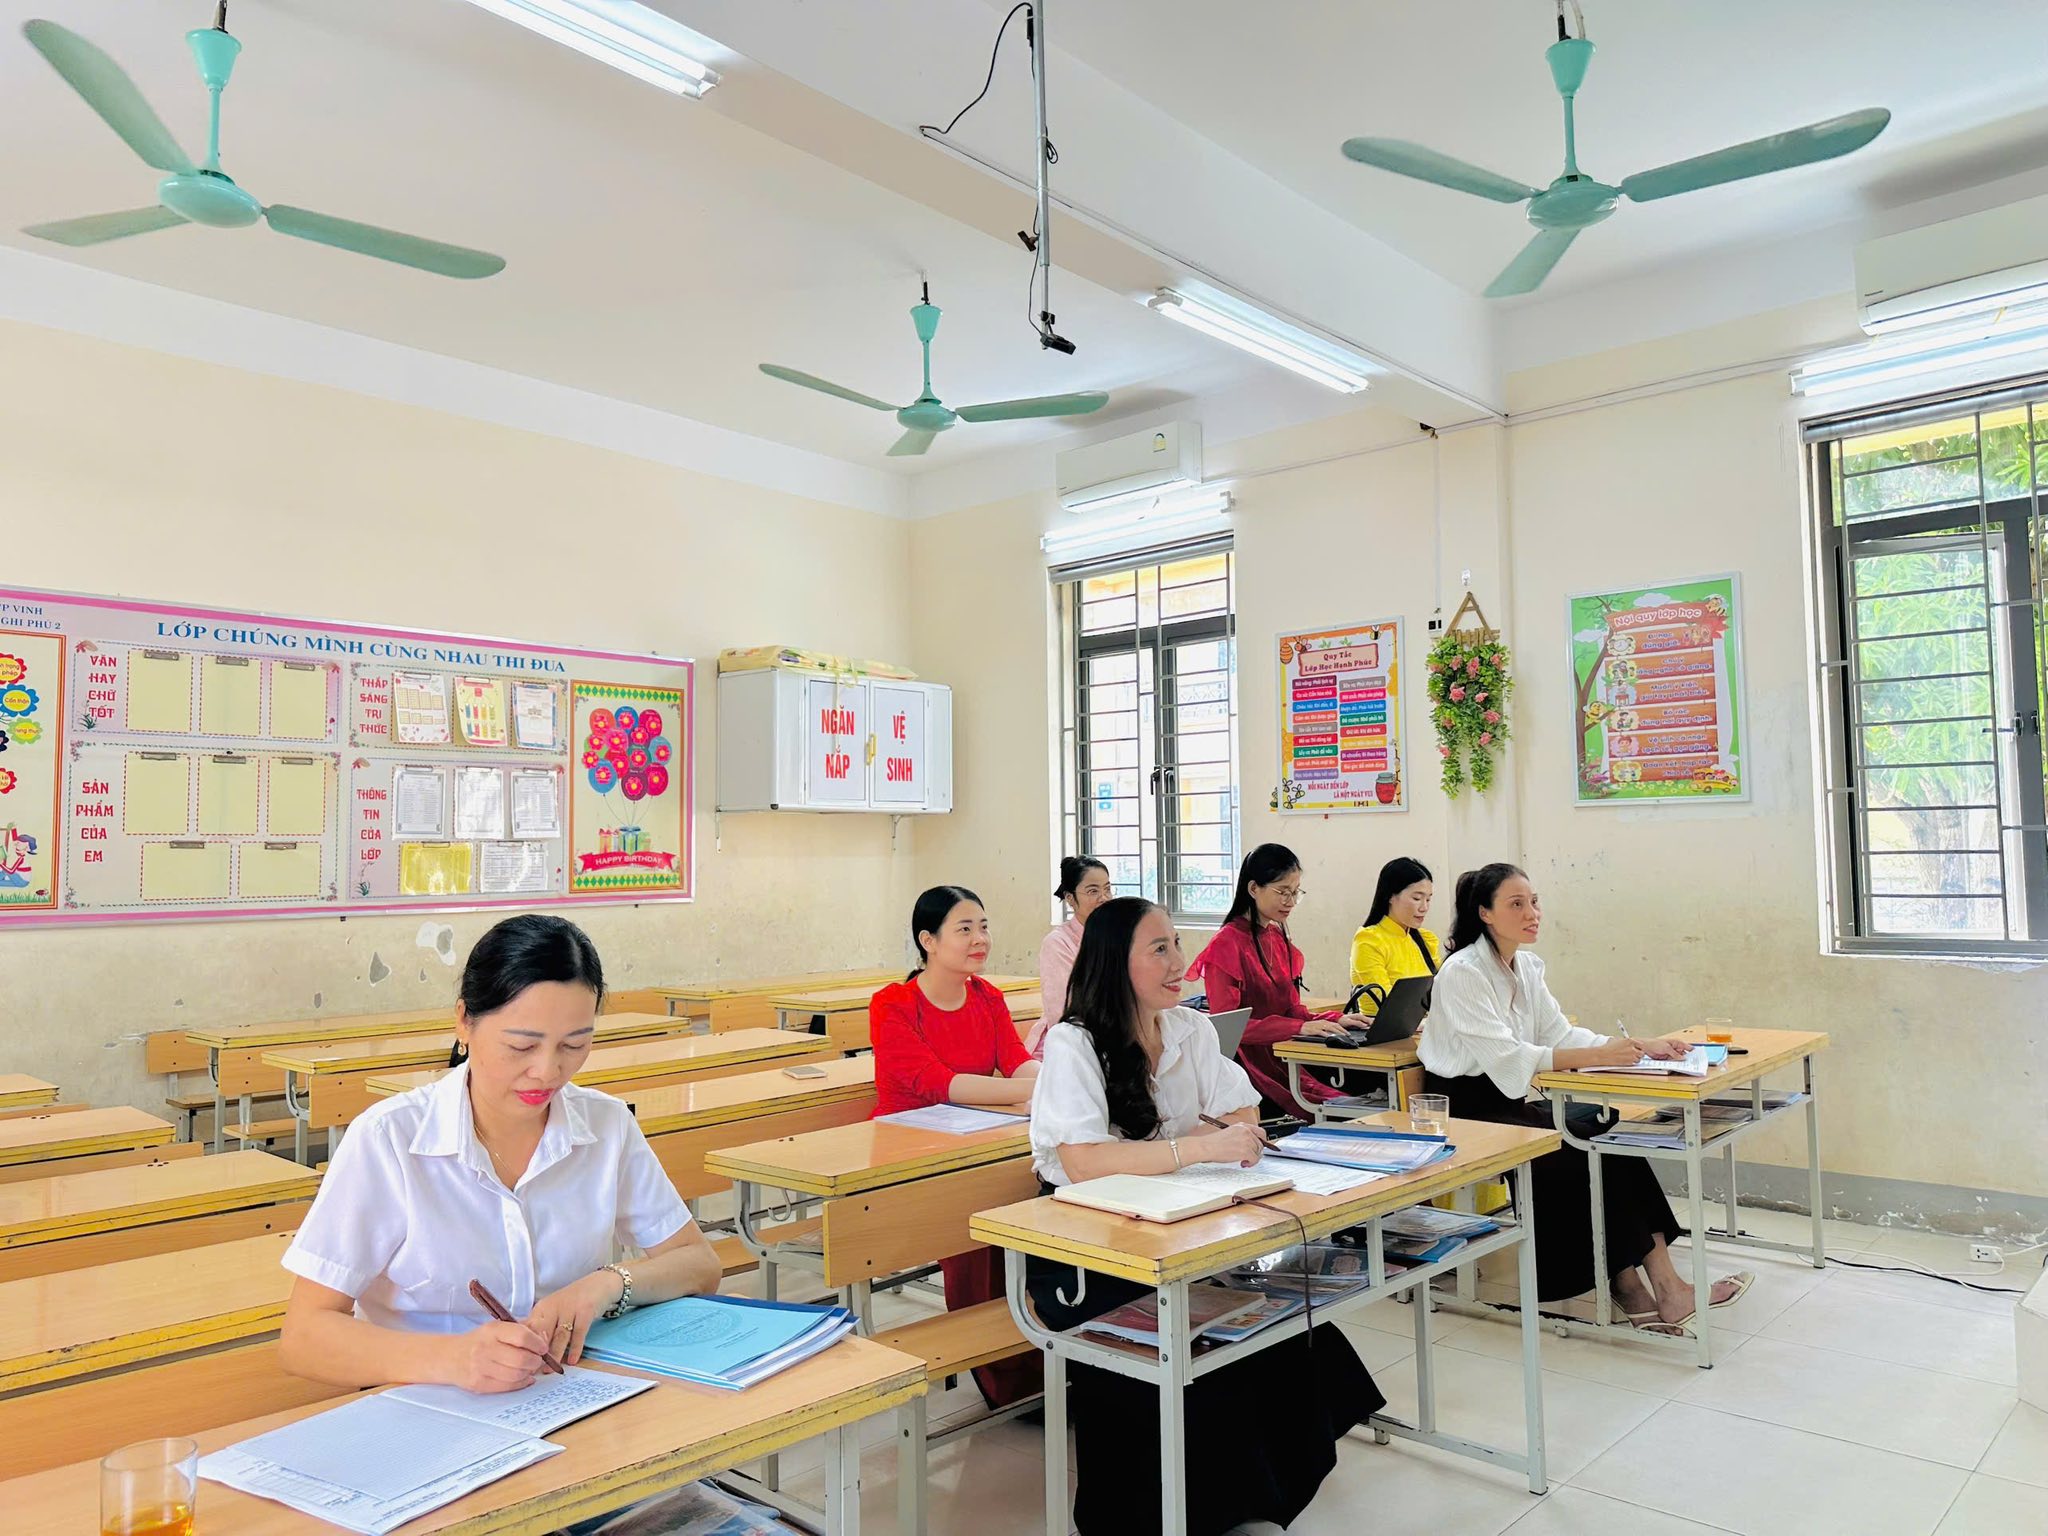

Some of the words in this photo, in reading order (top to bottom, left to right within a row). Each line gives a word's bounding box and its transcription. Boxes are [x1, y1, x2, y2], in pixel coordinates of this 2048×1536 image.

[13, 605, 42, 615] VINH
[1614, 614, 1634, 627] Nội
[1636, 611, 1657, 623] quy
[1658, 608, 1677, 620] lớp
[1678, 607, 1702, 619] học
[157, 621, 207, 639] LỚP
[213, 628, 297, 648] CHÚNG
[305, 635, 364, 654] MÌNH
[370, 642, 427, 660] CÙNG
[434, 649, 488, 666] NHAU
[492, 655, 526, 669] THI
[531, 659, 566, 673] ĐUA
[90, 654, 117, 667] VĂN
[1323, 653, 1337, 661] Quy
[89, 673, 117, 684] HAY
[89, 690, 117, 701] CHỮ
[89, 704, 115, 718] TỐT
[821, 704, 855, 736] NGĂN
[892, 710, 906, 745] VỆ
[825, 744, 851, 779] NẮP
[886, 757, 913, 782] SINH
[82, 779, 109, 794] SẢN
[357, 787, 387, 800] THÔNG
[76, 800, 114, 817] PHẨM
[363, 809, 380, 820] TIN
[81, 824, 107, 839] CỦA
[361, 827, 381, 840] CỦA
[84, 850, 103, 862] EM
[361, 848, 381, 860] LỚP
[595, 855, 623, 865] HAPPY
[623, 855, 662, 864] BIRTHDAY
